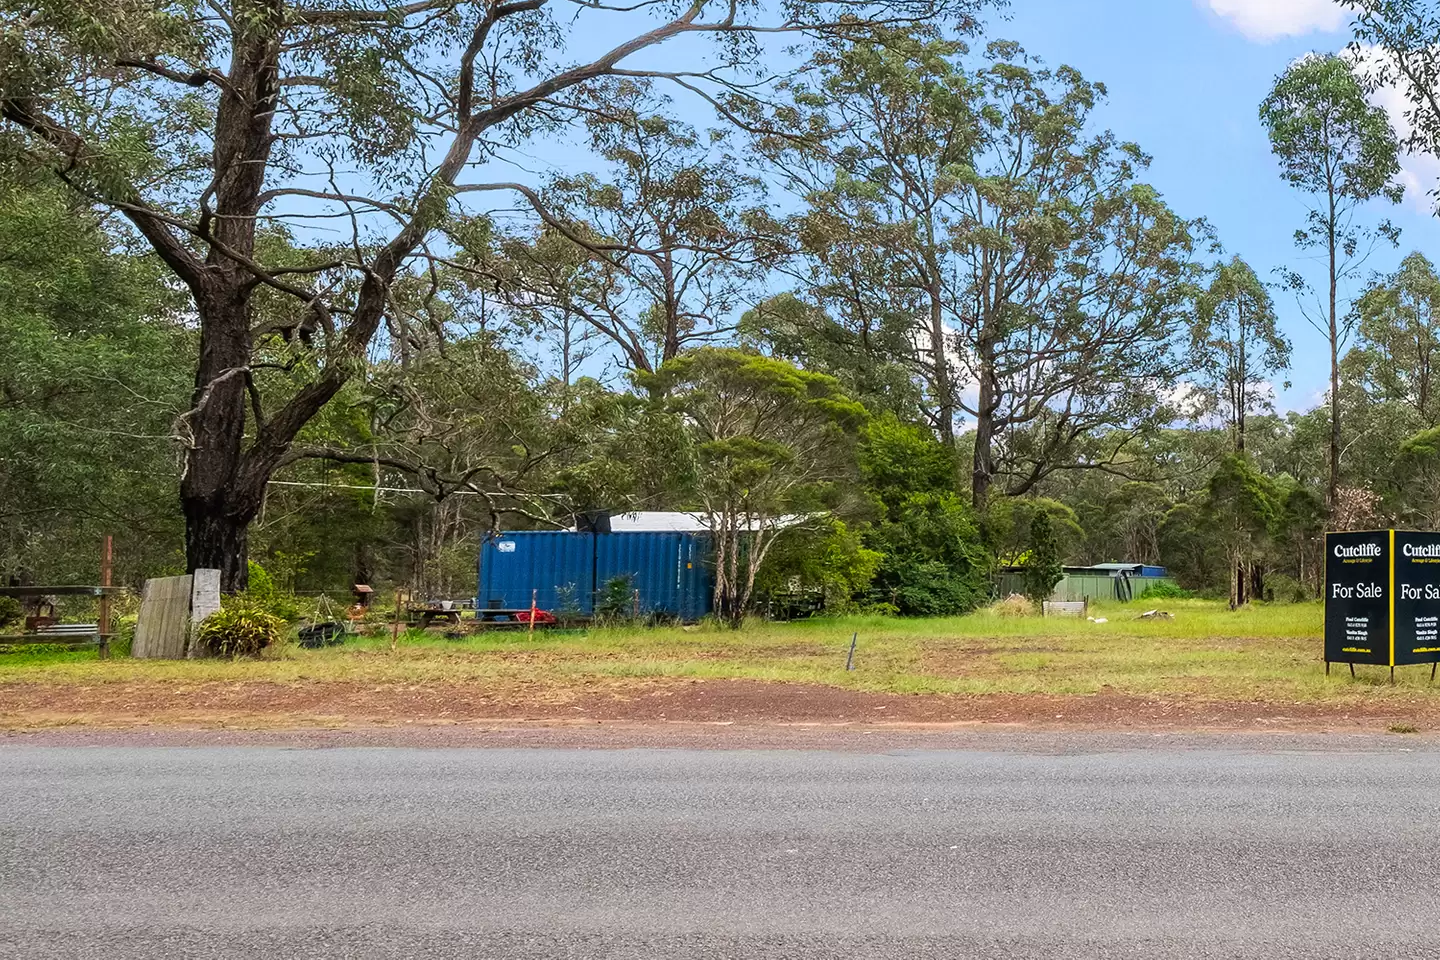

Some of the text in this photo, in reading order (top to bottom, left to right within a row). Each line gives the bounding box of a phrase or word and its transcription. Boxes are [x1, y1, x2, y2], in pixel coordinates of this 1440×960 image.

[1334, 543, 1381, 557] Cutcliffe
[1332, 582, 1382, 598] For Sale
[1401, 584, 1422, 599] For
